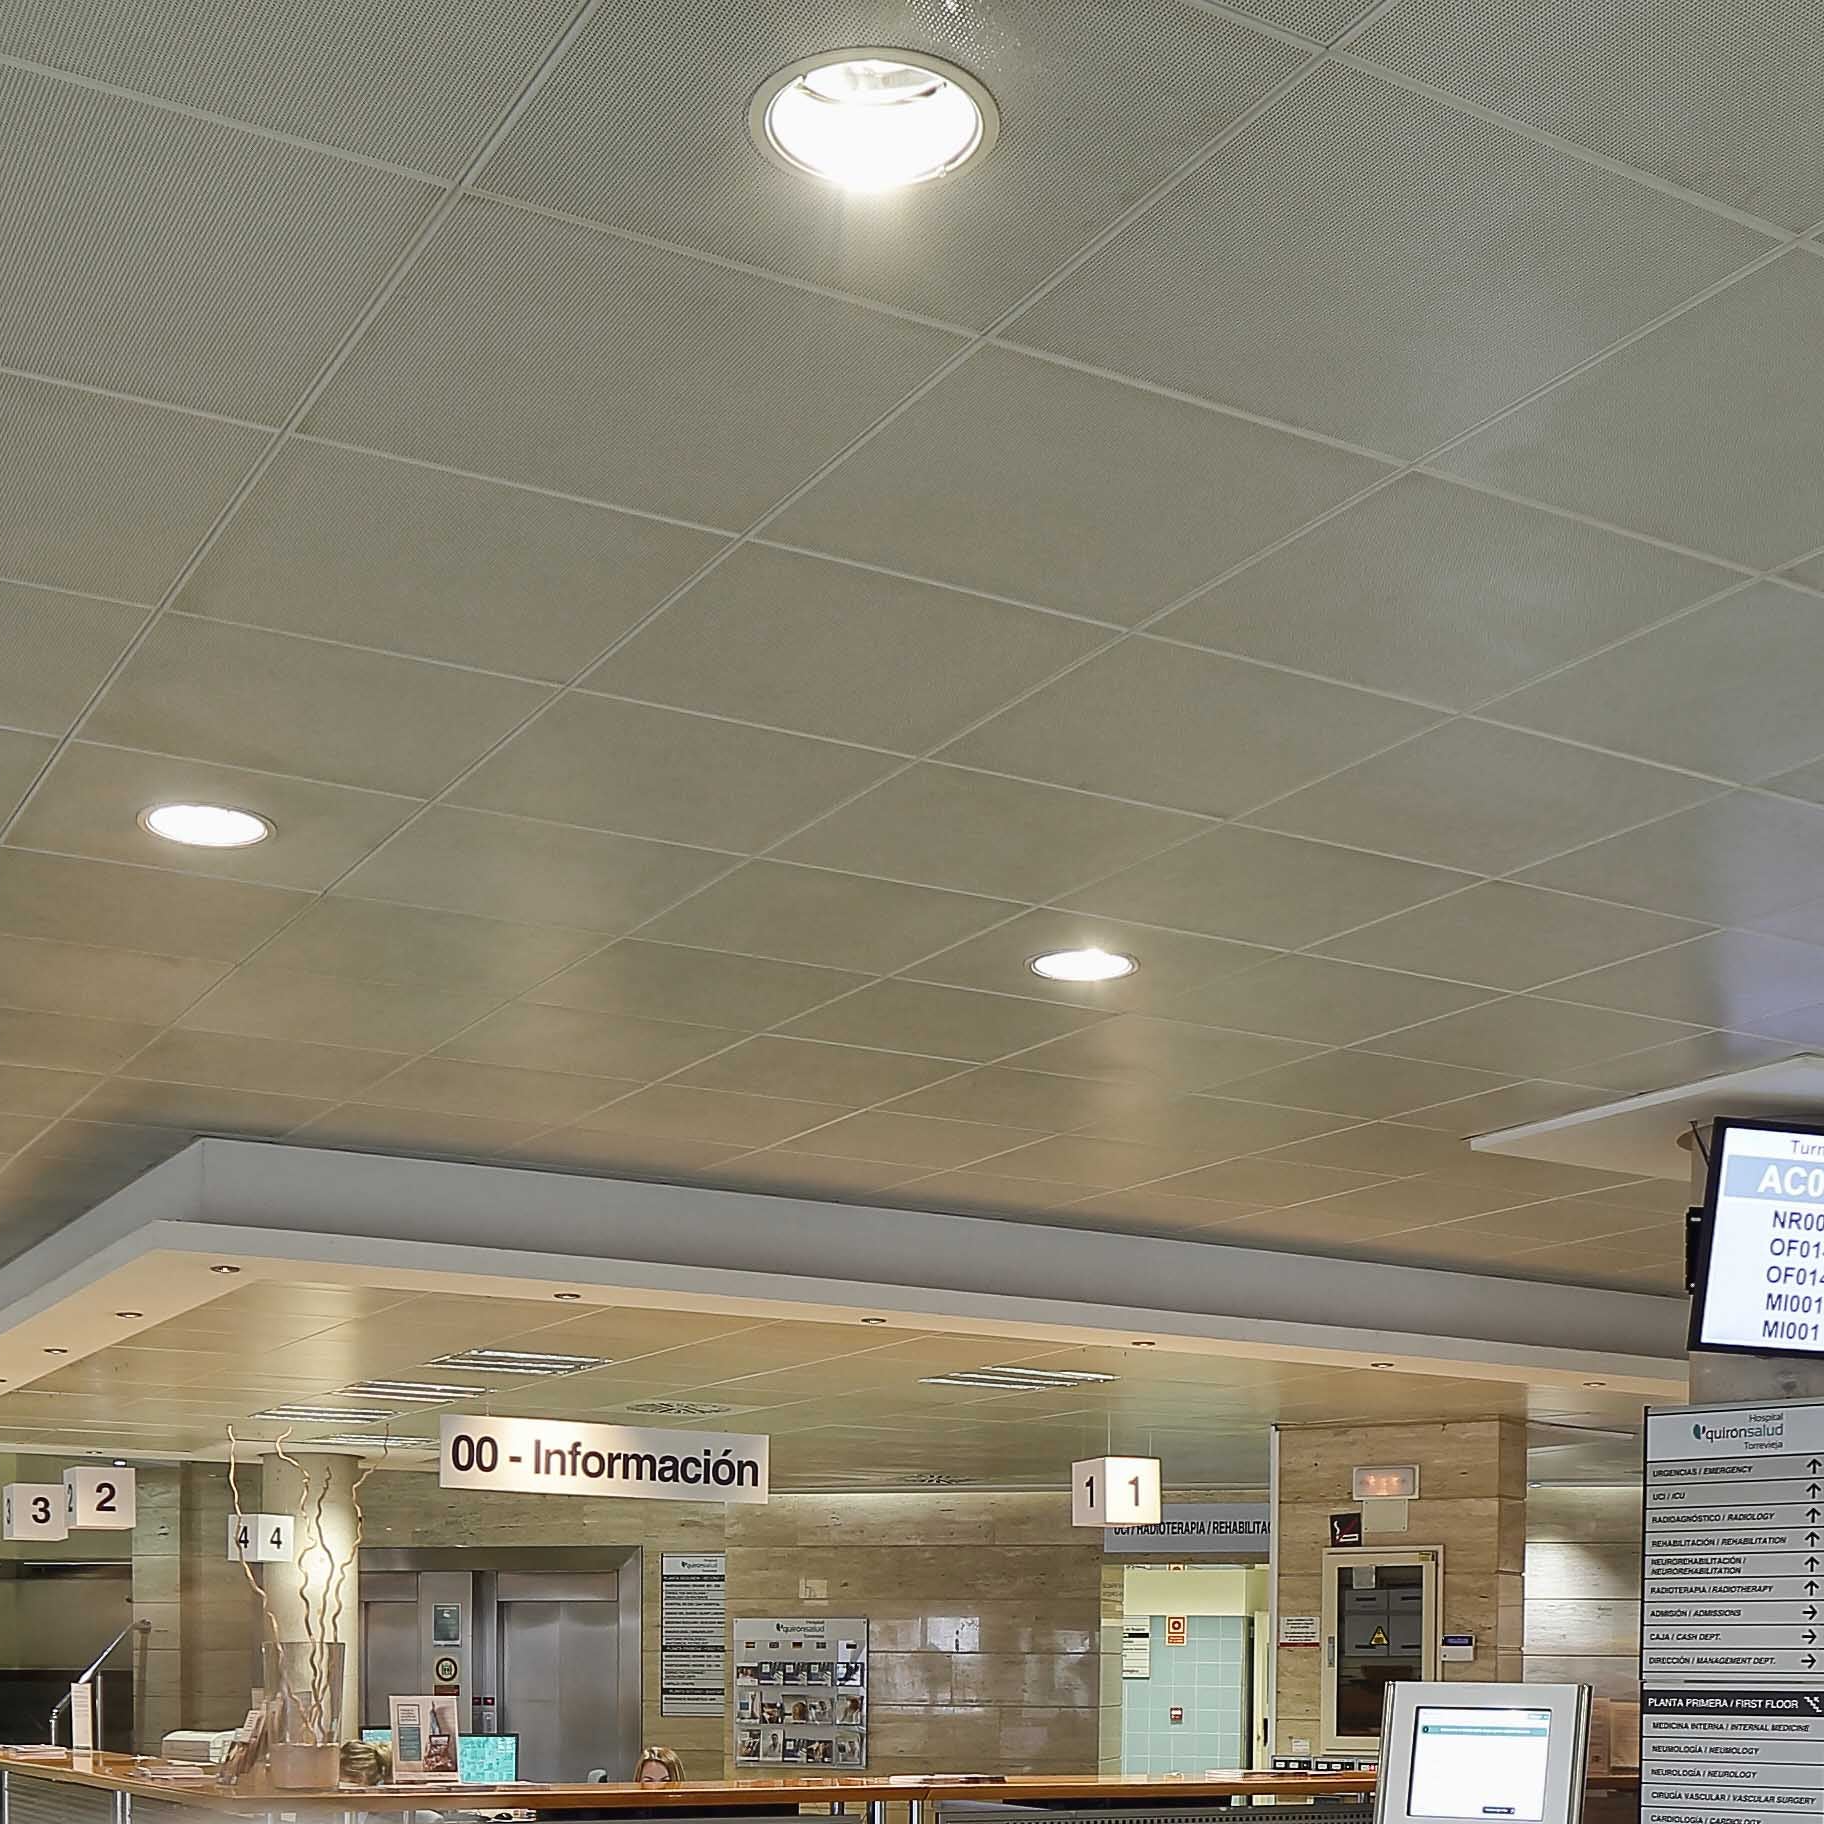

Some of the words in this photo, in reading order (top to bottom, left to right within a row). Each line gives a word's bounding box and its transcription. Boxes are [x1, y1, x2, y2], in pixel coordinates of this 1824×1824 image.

[1765, 1293, 1823, 1314] MI001
[1762, 1320, 1819, 1341] MI001
[1749, 1413, 1783, 1423] Hospital
[1744, 1441, 1783, 1450] Torrevieja
[451, 1434, 499, 1472] 00
[534, 1439, 759, 1488] Información
[1652, 1469, 1697, 1477] URGENCIAS
[1703, 1466, 1753, 1475] EMERGENCY
[1085, 1476, 1094, 1508] 1
[1128, 1476, 1139, 1506] 1
[95, 1482, 117, 1512] 2
[1652, 1493, 1666, 1501] UCI
[1671, 1492, 1685, 1500] ICU
[31, 1497, 51, 1524] 3
[1728, 1512, 1775, 1521] RADIOLOGY
[1137, 1521, 1205, 1535] RADIOTERAPIA
[238, 1526, 250, 1549] 4
[270, 1527, 282, 1549] 4
[1722, 1536, 1787, 1546] REHABILITATION
[1651, 1567, 1741, 1575] NEUROREHABILITATION
[1651, 1586, 1707, 1594] RADIOTERAPIA
[1712, 1585, 1773, 1593] RADIOTHERAPY
[1693, 1609, 1741, 1617] ADMISSIONS
[1650, 1633, 1670, 1641] CAJA
[1676, 1633, 1697, 1641] CASH
[1699, 1633, 1722, 1641] DEPT.
[1697, 1657, 1752, 1665] MANAGEMENT
[1753, 1657, 1776, 1665] DEPT.
[1648, 1698, 1684, 1707] PLANTA
[1686, 1699, 1727, 1708] PRIMERA
[1736, 1699, 1762, 1708] FIRST
[1765, 1700, 1799, 1708] FLOOR
[1653, 1722, 1689, 1730] MEDICINA
[1684, 1793, 1725, 1801] VASCULAR
[1733, 1794, 1775, 1803] VASCULAR
[1776, 1796, 1816, 1805] SURGERY
